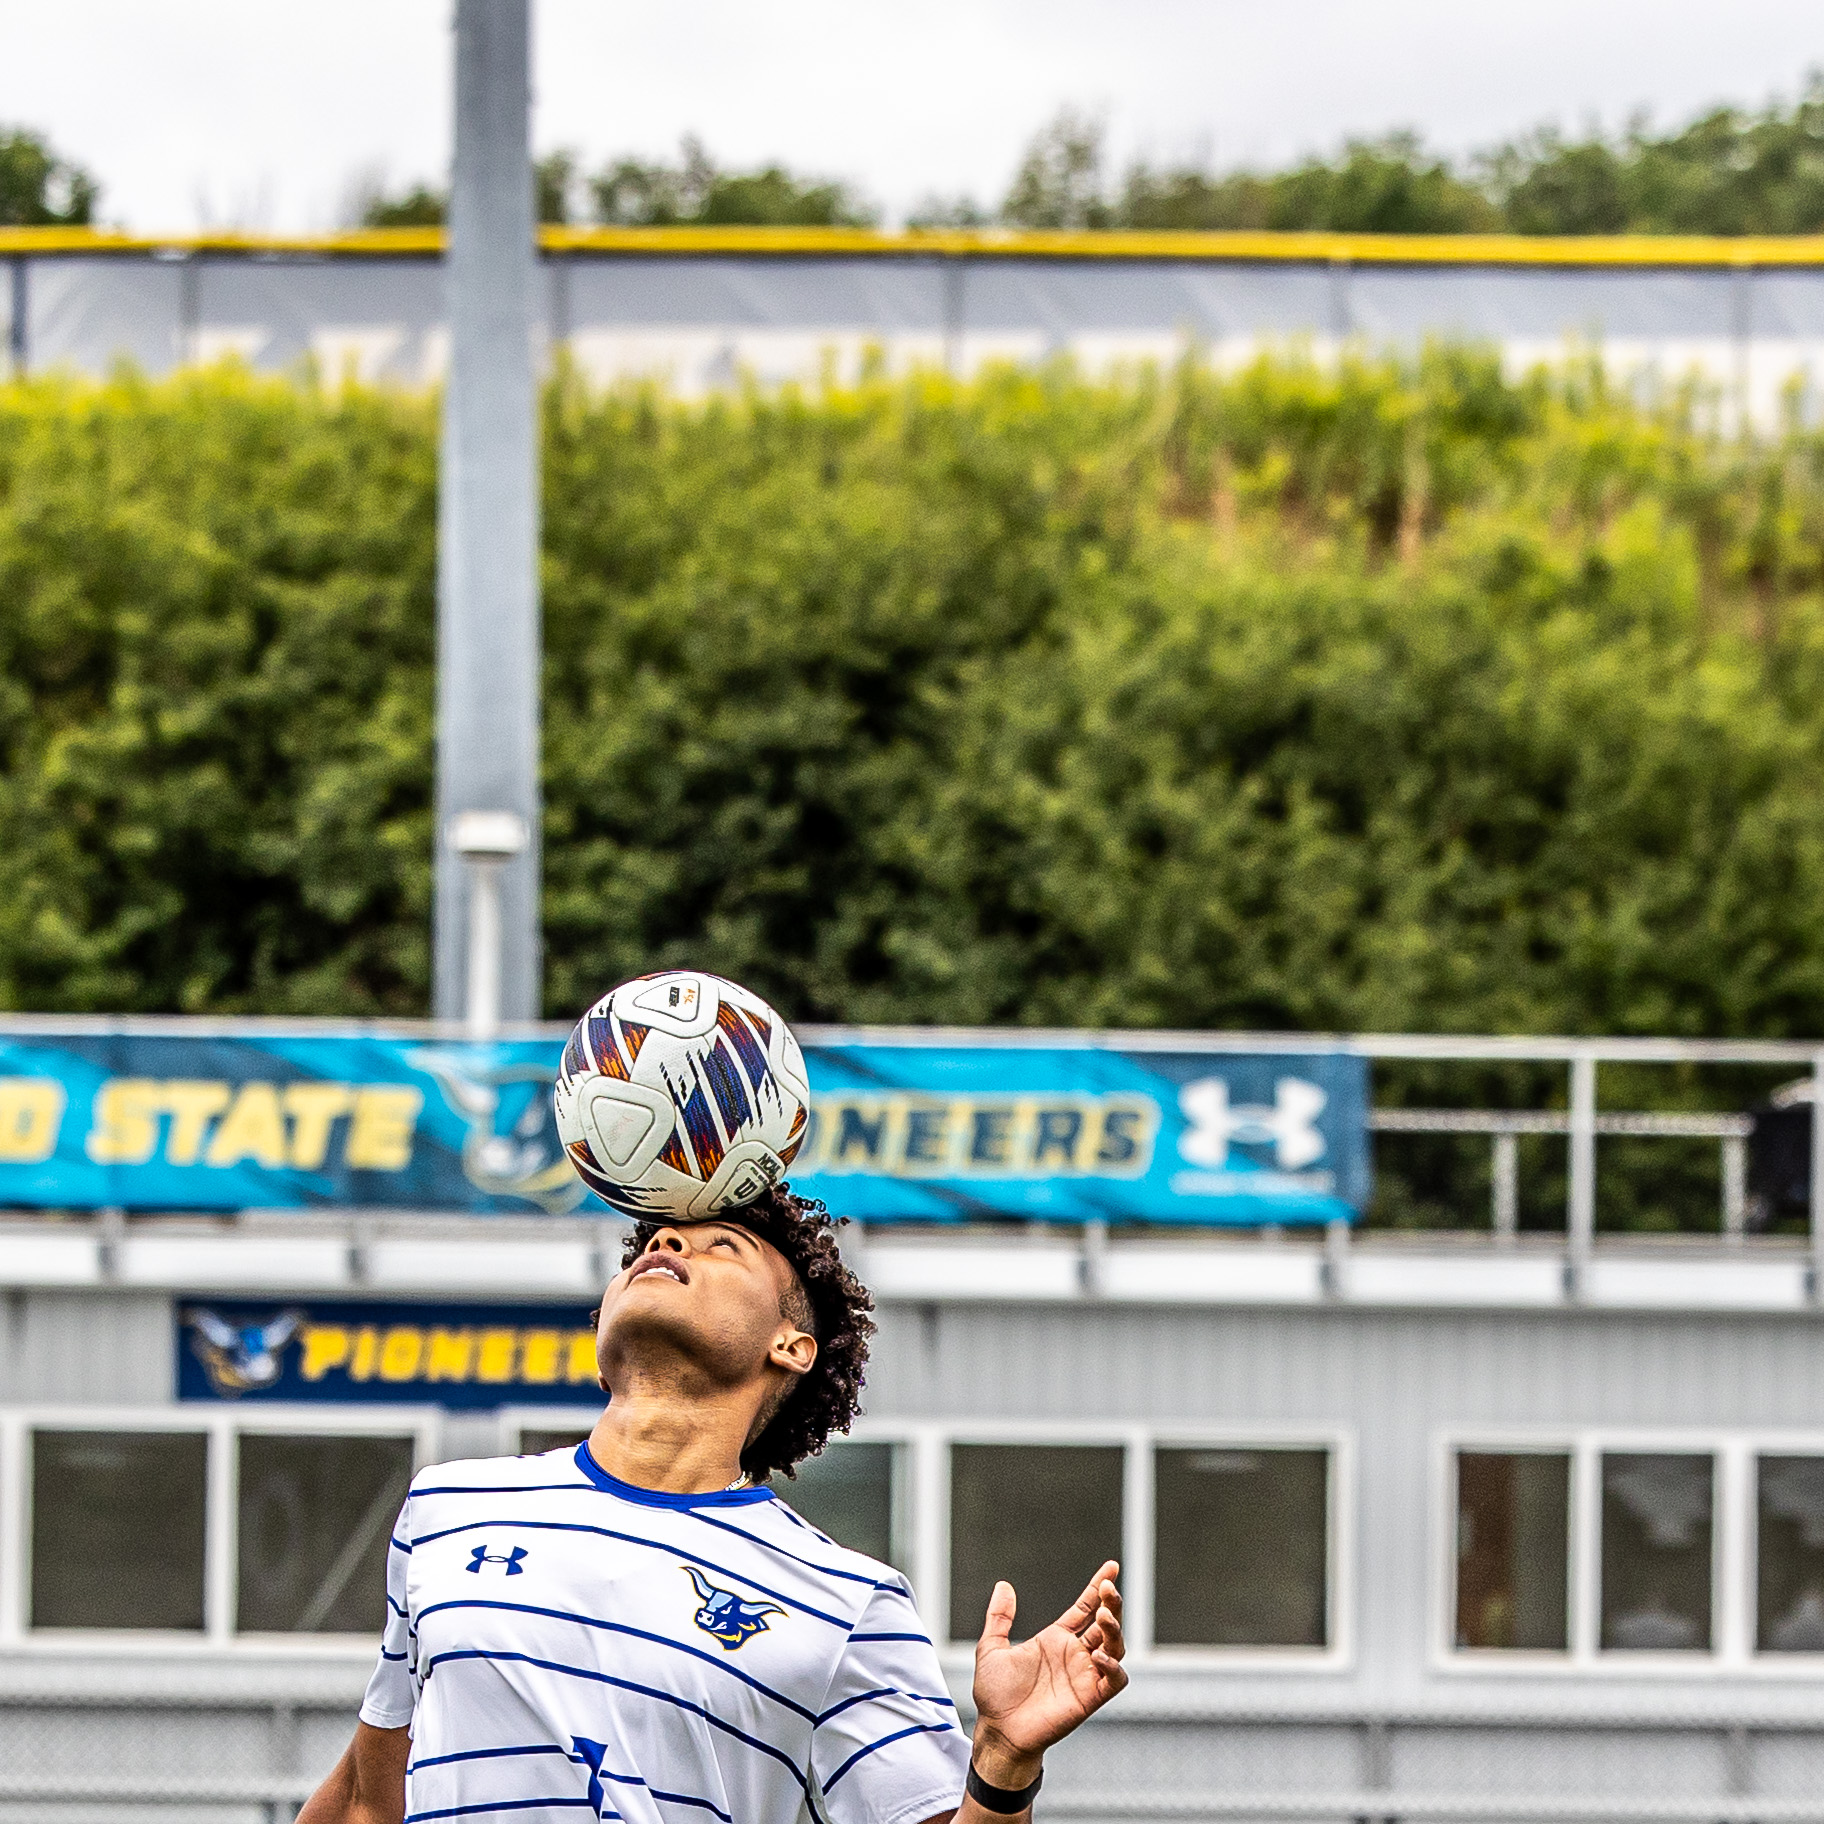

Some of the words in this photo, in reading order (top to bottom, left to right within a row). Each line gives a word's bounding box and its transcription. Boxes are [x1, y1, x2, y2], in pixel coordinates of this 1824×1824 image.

[87, 1079, 421, 1172] STATE
[798, 1096, 1154, 1174] NEERS
[301, 1325, 598, 1383] PIONEER
